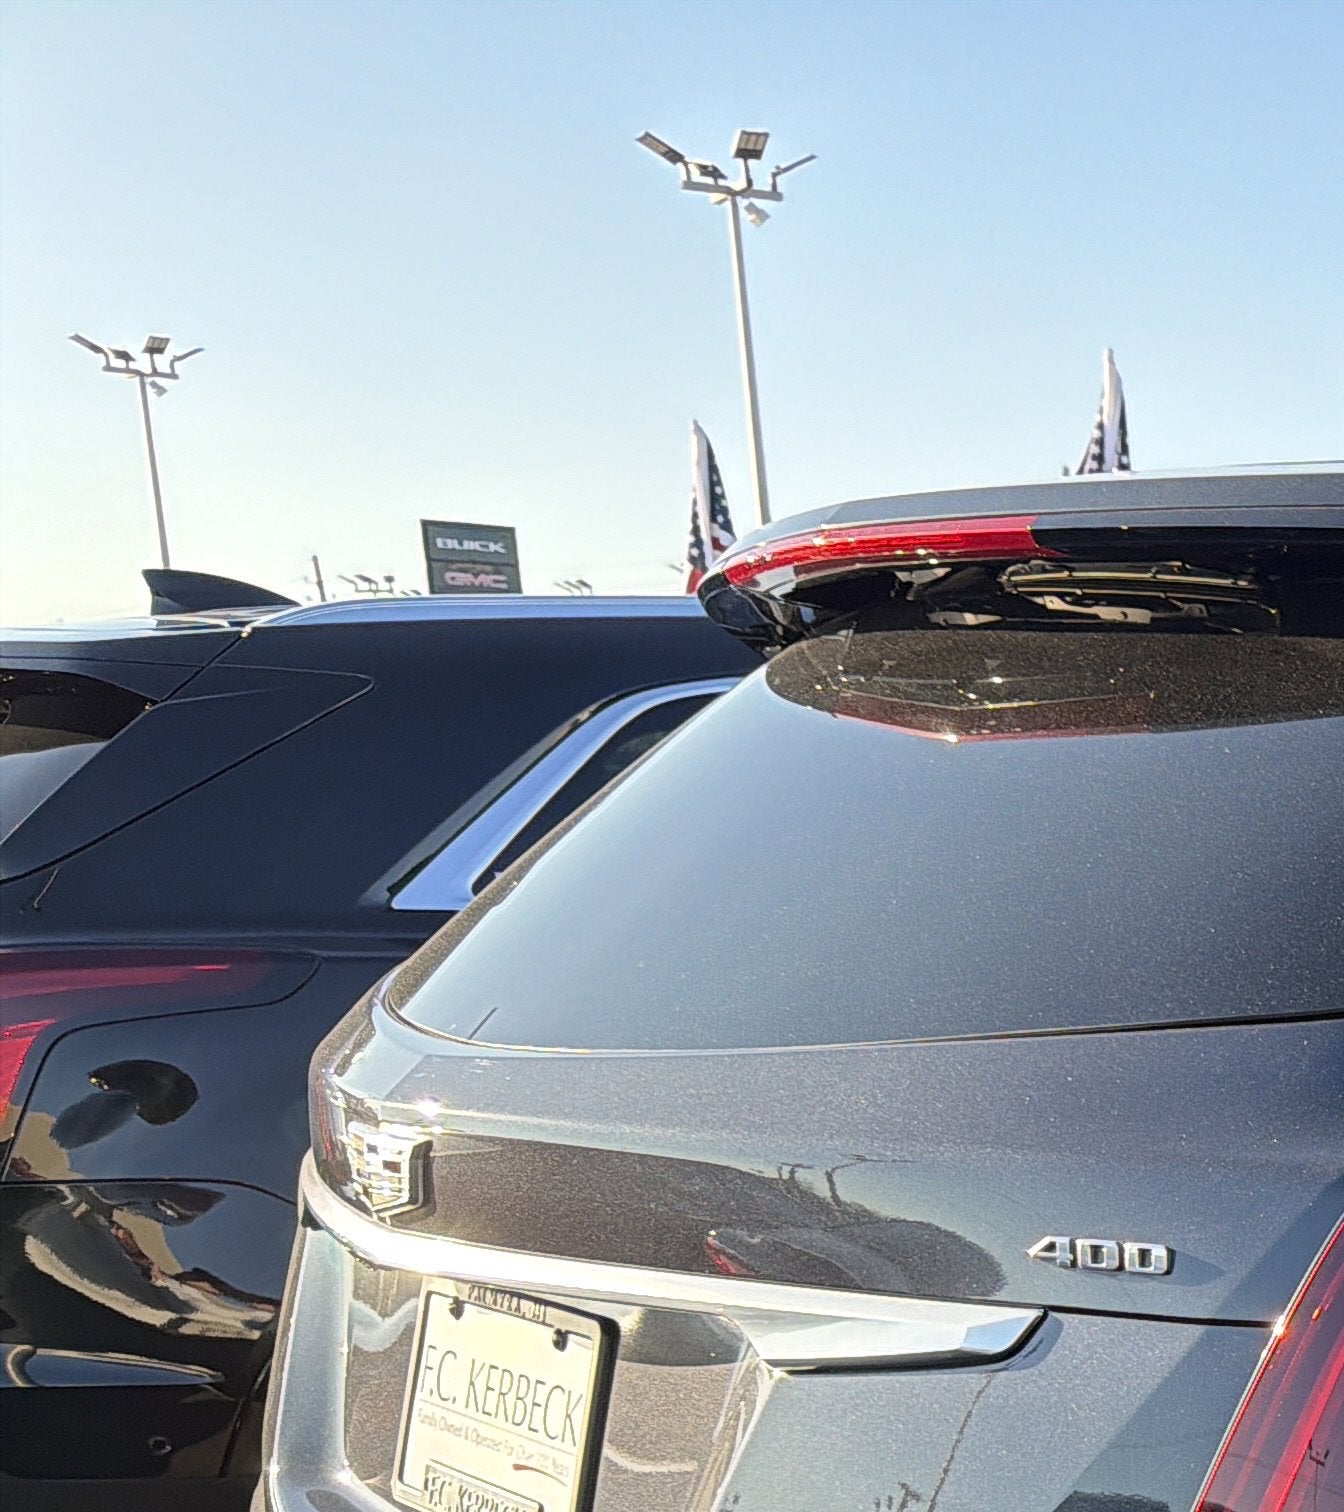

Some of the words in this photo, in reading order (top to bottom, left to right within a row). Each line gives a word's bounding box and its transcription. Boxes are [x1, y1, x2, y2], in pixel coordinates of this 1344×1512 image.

[435, 537, 507, 554] BUICK
[444, 571, 508, 589] GMC
[1025, 1235, 1174, 1276] 400
[420, 1344, 457, 1405] F.C.
[464, 1357, 584, 1447] KERBECK
